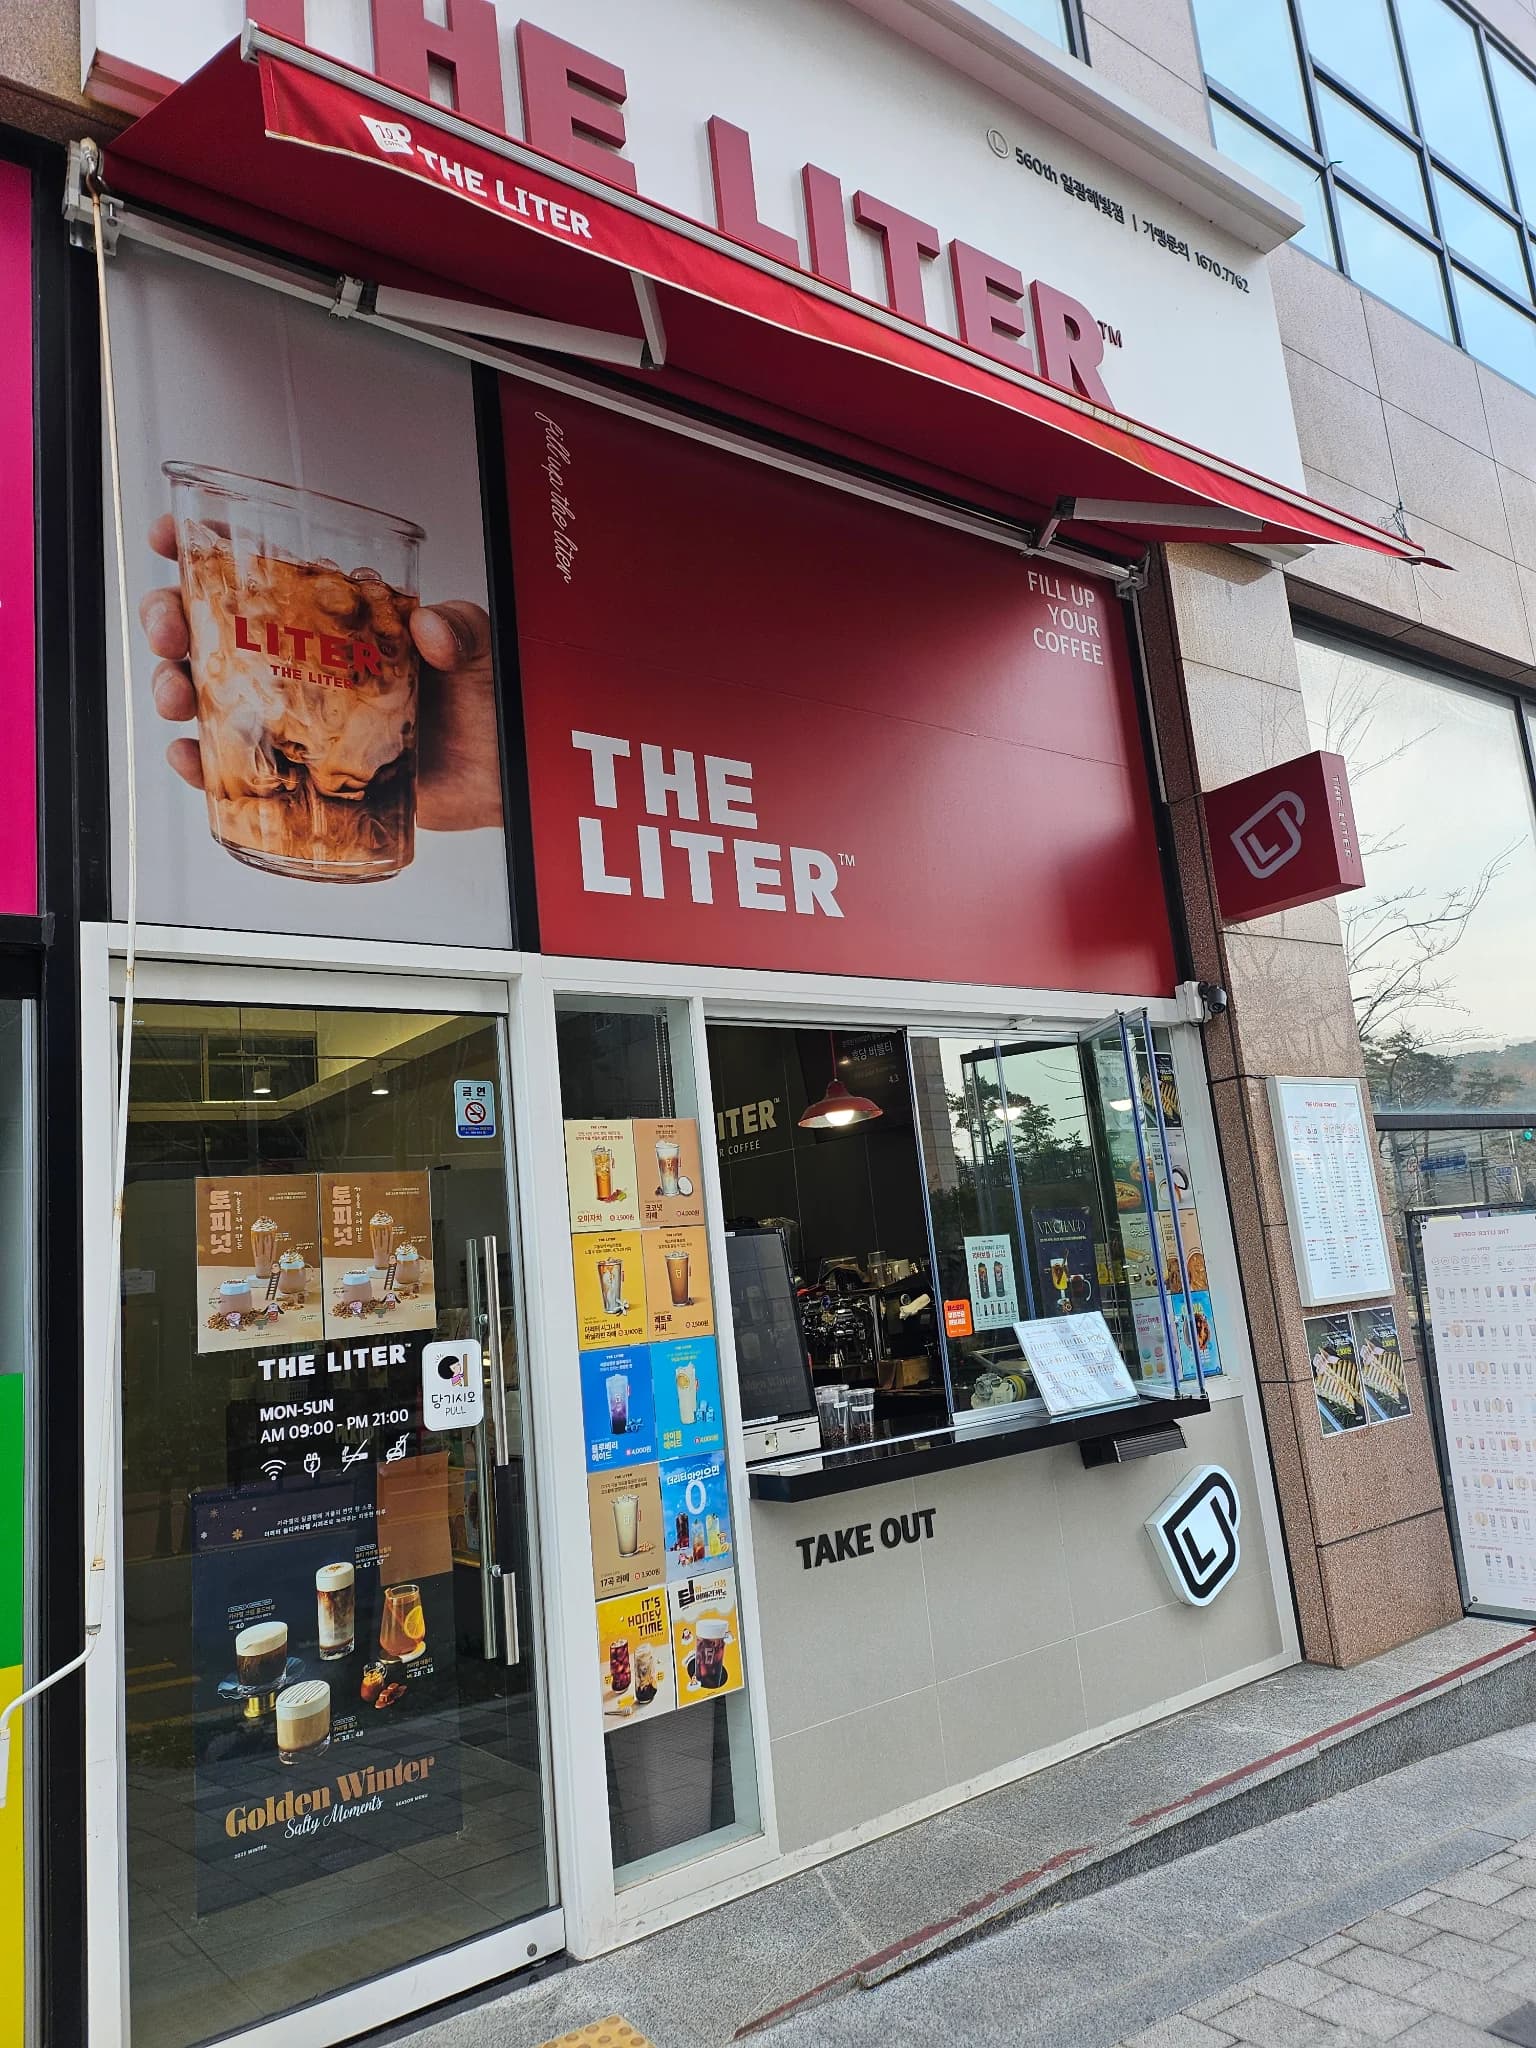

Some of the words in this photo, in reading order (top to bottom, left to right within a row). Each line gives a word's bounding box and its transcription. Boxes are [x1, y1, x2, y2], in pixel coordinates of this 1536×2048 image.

[247, 0, 638, 193] HE
[707, 114, 1116, 410] LITER
[417, 145, 487, 197] THE
[496, 180, 593, 239] LITER
[1015, 147, 1058, 185] 560th
[1142, 220, 1190, 262] 가맹문의
[1194, 251, 1250, 294] 1670.7762
[1027, 570, 1066, 601] FILL
[1071, 584, 1095, 609] UP
[1047, 603, 1100, 638] YOUR
[235, 615, 382, 676] LITER
[1033, 627, 1104, 666] COFFEE
[270, 664, 302, 681] THE
[309, 671, 353, 690] LITER
[571, 730, 758, 830] THE
[578, 816, 845, 918] LITER
[716, 1099, 777, 1141] ITER
[728, 1139, 761, 1156] COFFEE
[209, 1190, 232, 1255] 토피넛
[332, 1185, 353, 1247] 토피넛
[258, 1354, 316, 1381] THE
[327, 1344, 407, 1373] LITER
[260, 1398, 334, 1422] MON-SUN
[431, 1391, 476, 1409] 당기시오
[445, 1405, 467, 1417] PULL
[260, 1428, 285, 1444] AM
[289, 1420, 334, 1438] 09:00
[347, 1416, 369, 1431] PM
[372, 1408, 409, 1426] 21:00
[796, 1523, 875, 1571] TAKE
[880, 1507, 938, 1550] OUT
[628, 1609, 662, 1628] HONEY
[641, 1596, 661, 1611] IT'S
[638, 1620, 664, 1637] TIME
[225, 1786, 331, 1838] Golden
[336, 1755, 435, 1802] Winter
[284, 1813, 320, 1839] Salty
[322, 1795, 384, 1828] Moments
